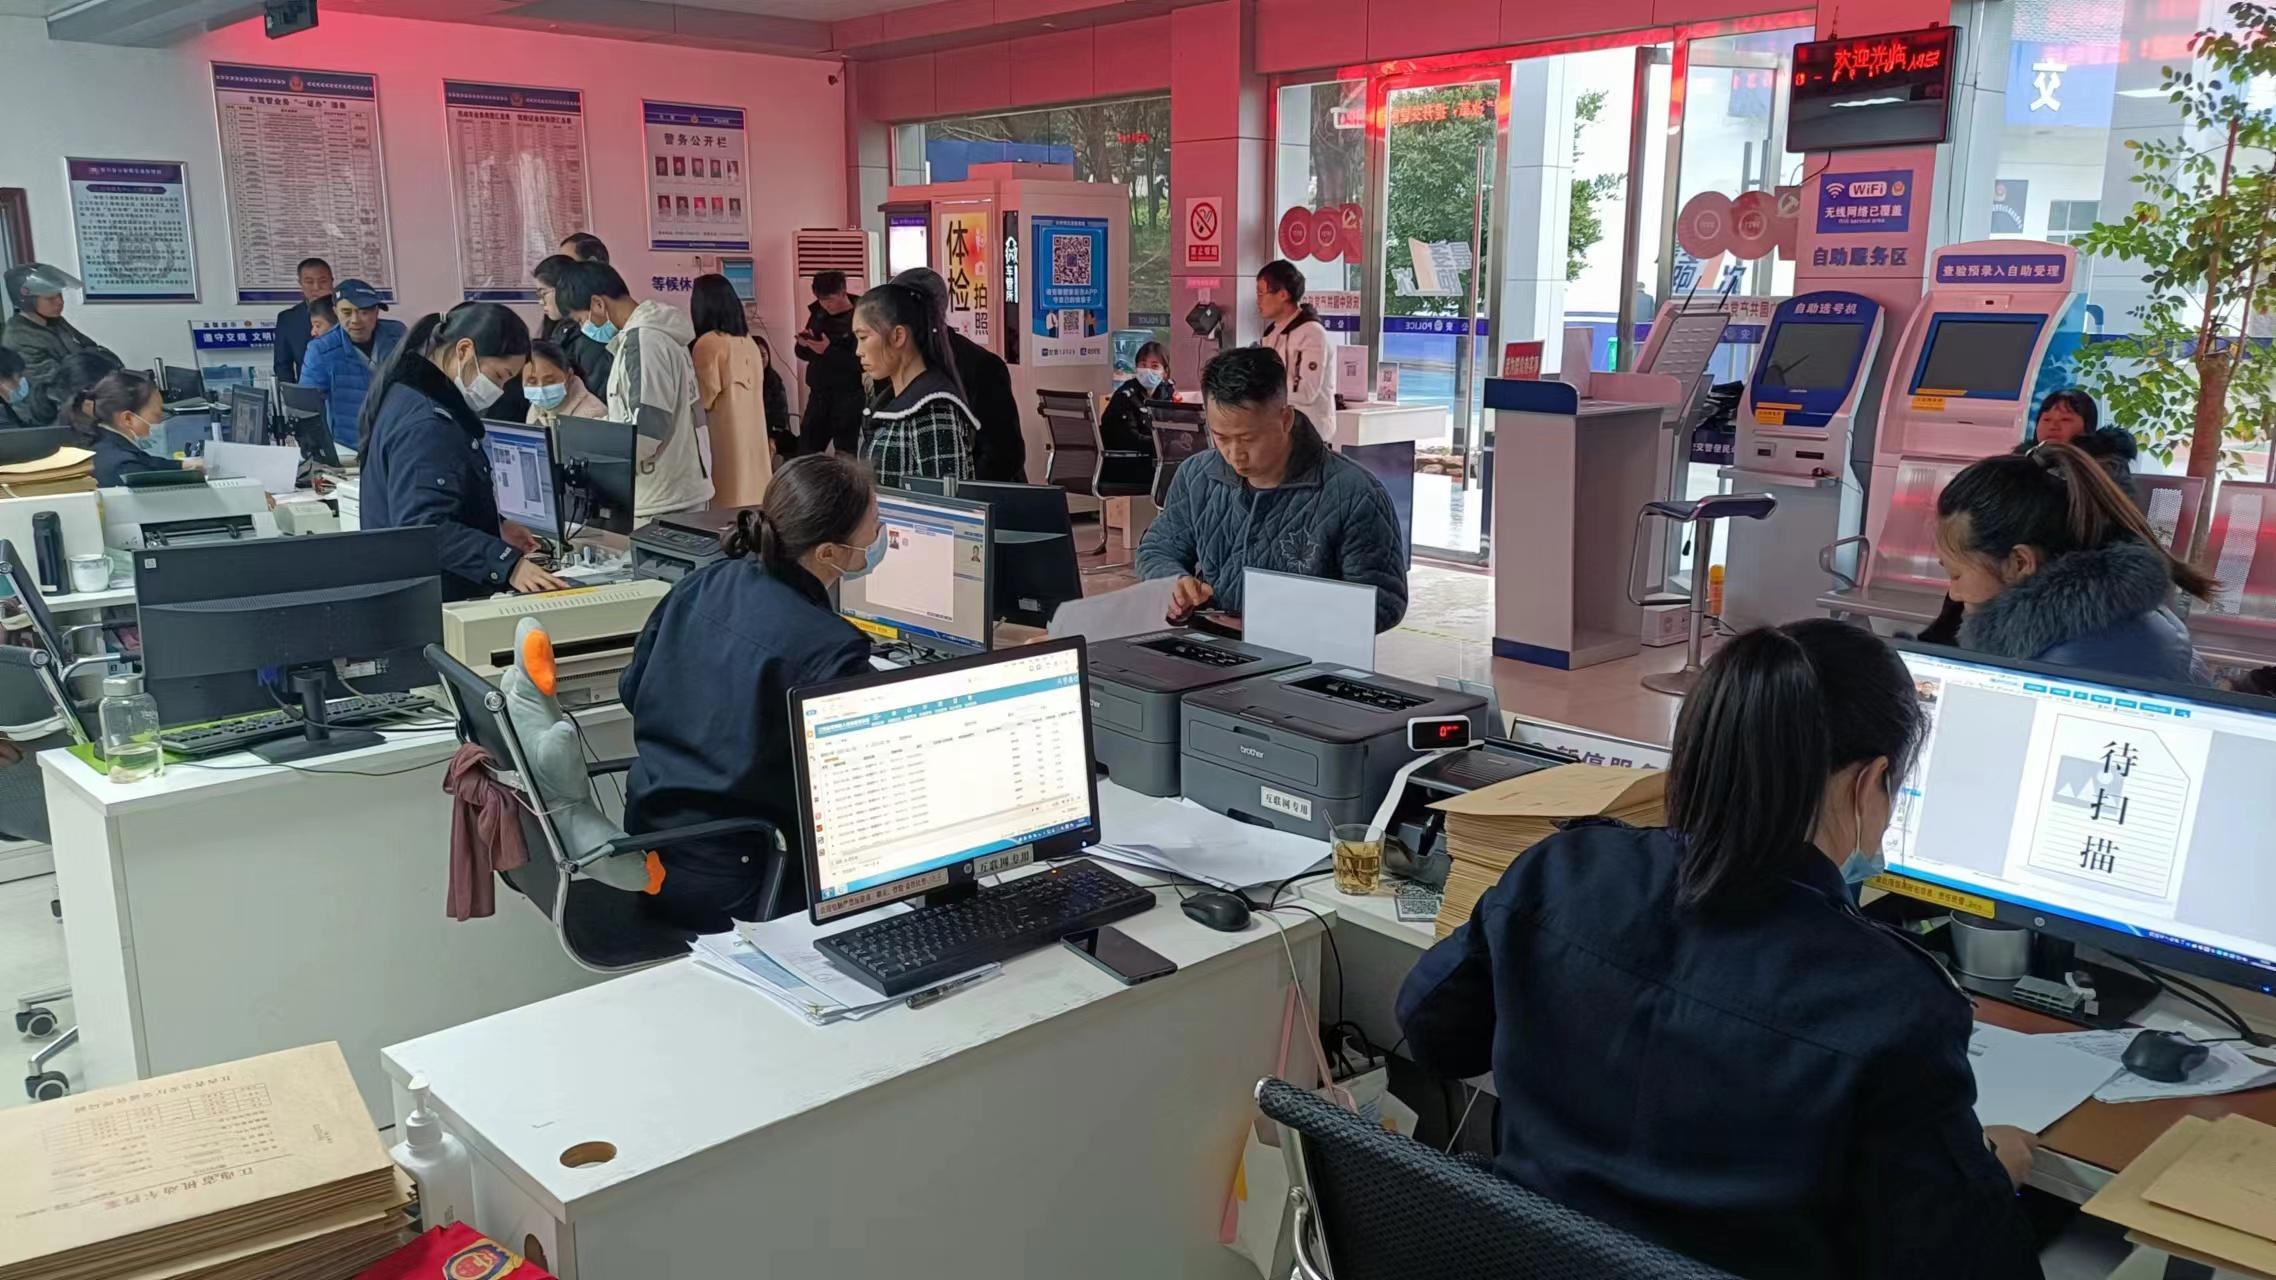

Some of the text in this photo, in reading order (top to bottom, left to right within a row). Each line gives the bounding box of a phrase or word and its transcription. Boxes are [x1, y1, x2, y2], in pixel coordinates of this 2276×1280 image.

[2030, 57, 2067, 112] 交
[664, 132, 728, 148] 警务公开栏
[1853, 183, 1884, 195] WiFi
[1825, 205, 1902, 218] 无线网络已覆盖
[1813, 246, 1909, 266] 自助服务区
[946, 220, 971, 313] 体检
[1943, 265, 2060, 277] 查验预录入自助受理
[652, 276, 694, 292] 等候休
[974, 283, 989, 336] 拍照
[1794, 303, 1857, 314] 自助选号机
[1240, 744, 1265, 759] brother
[1265, 792, 1309, 816] 互联网专用
[979, 850, 1030, 874] 互联网专用
